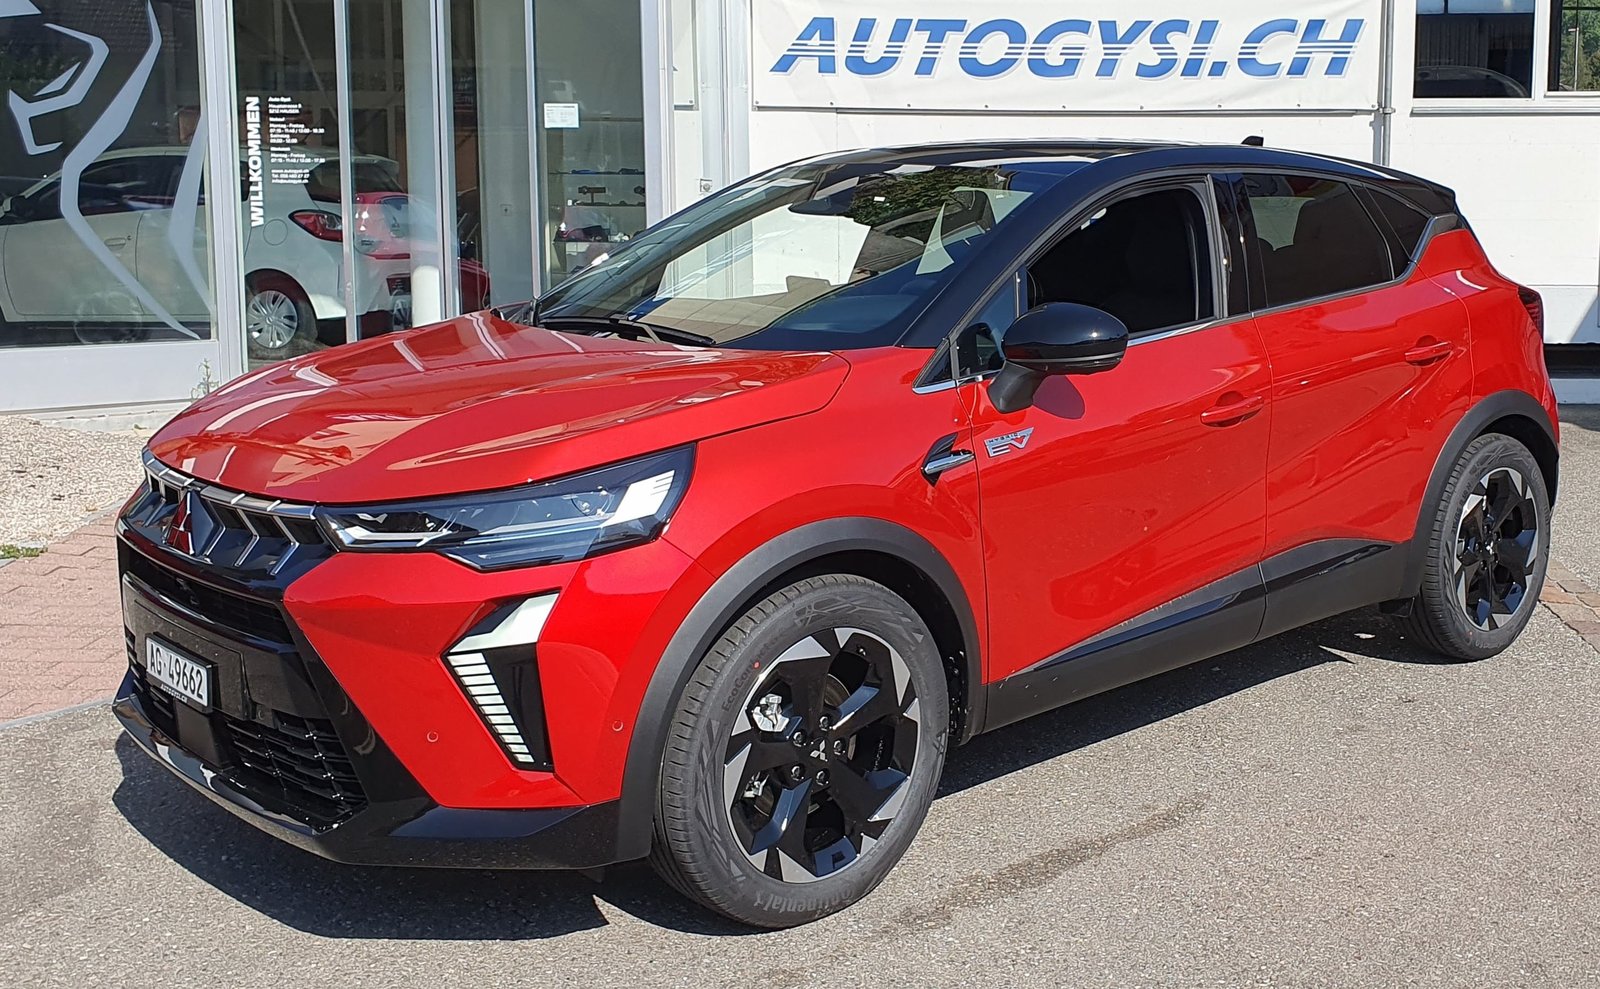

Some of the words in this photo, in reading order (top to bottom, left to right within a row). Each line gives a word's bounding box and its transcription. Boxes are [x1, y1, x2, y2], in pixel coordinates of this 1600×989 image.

[769, 17, 1366, 79] AUTOGYSI.CH
[246, 96, 265, 227] WILLKOMMEN
[984, 427, 1034, 457] EV
[150, 643, 162, 676] AG
[168, 654, 204, 700] 49662
